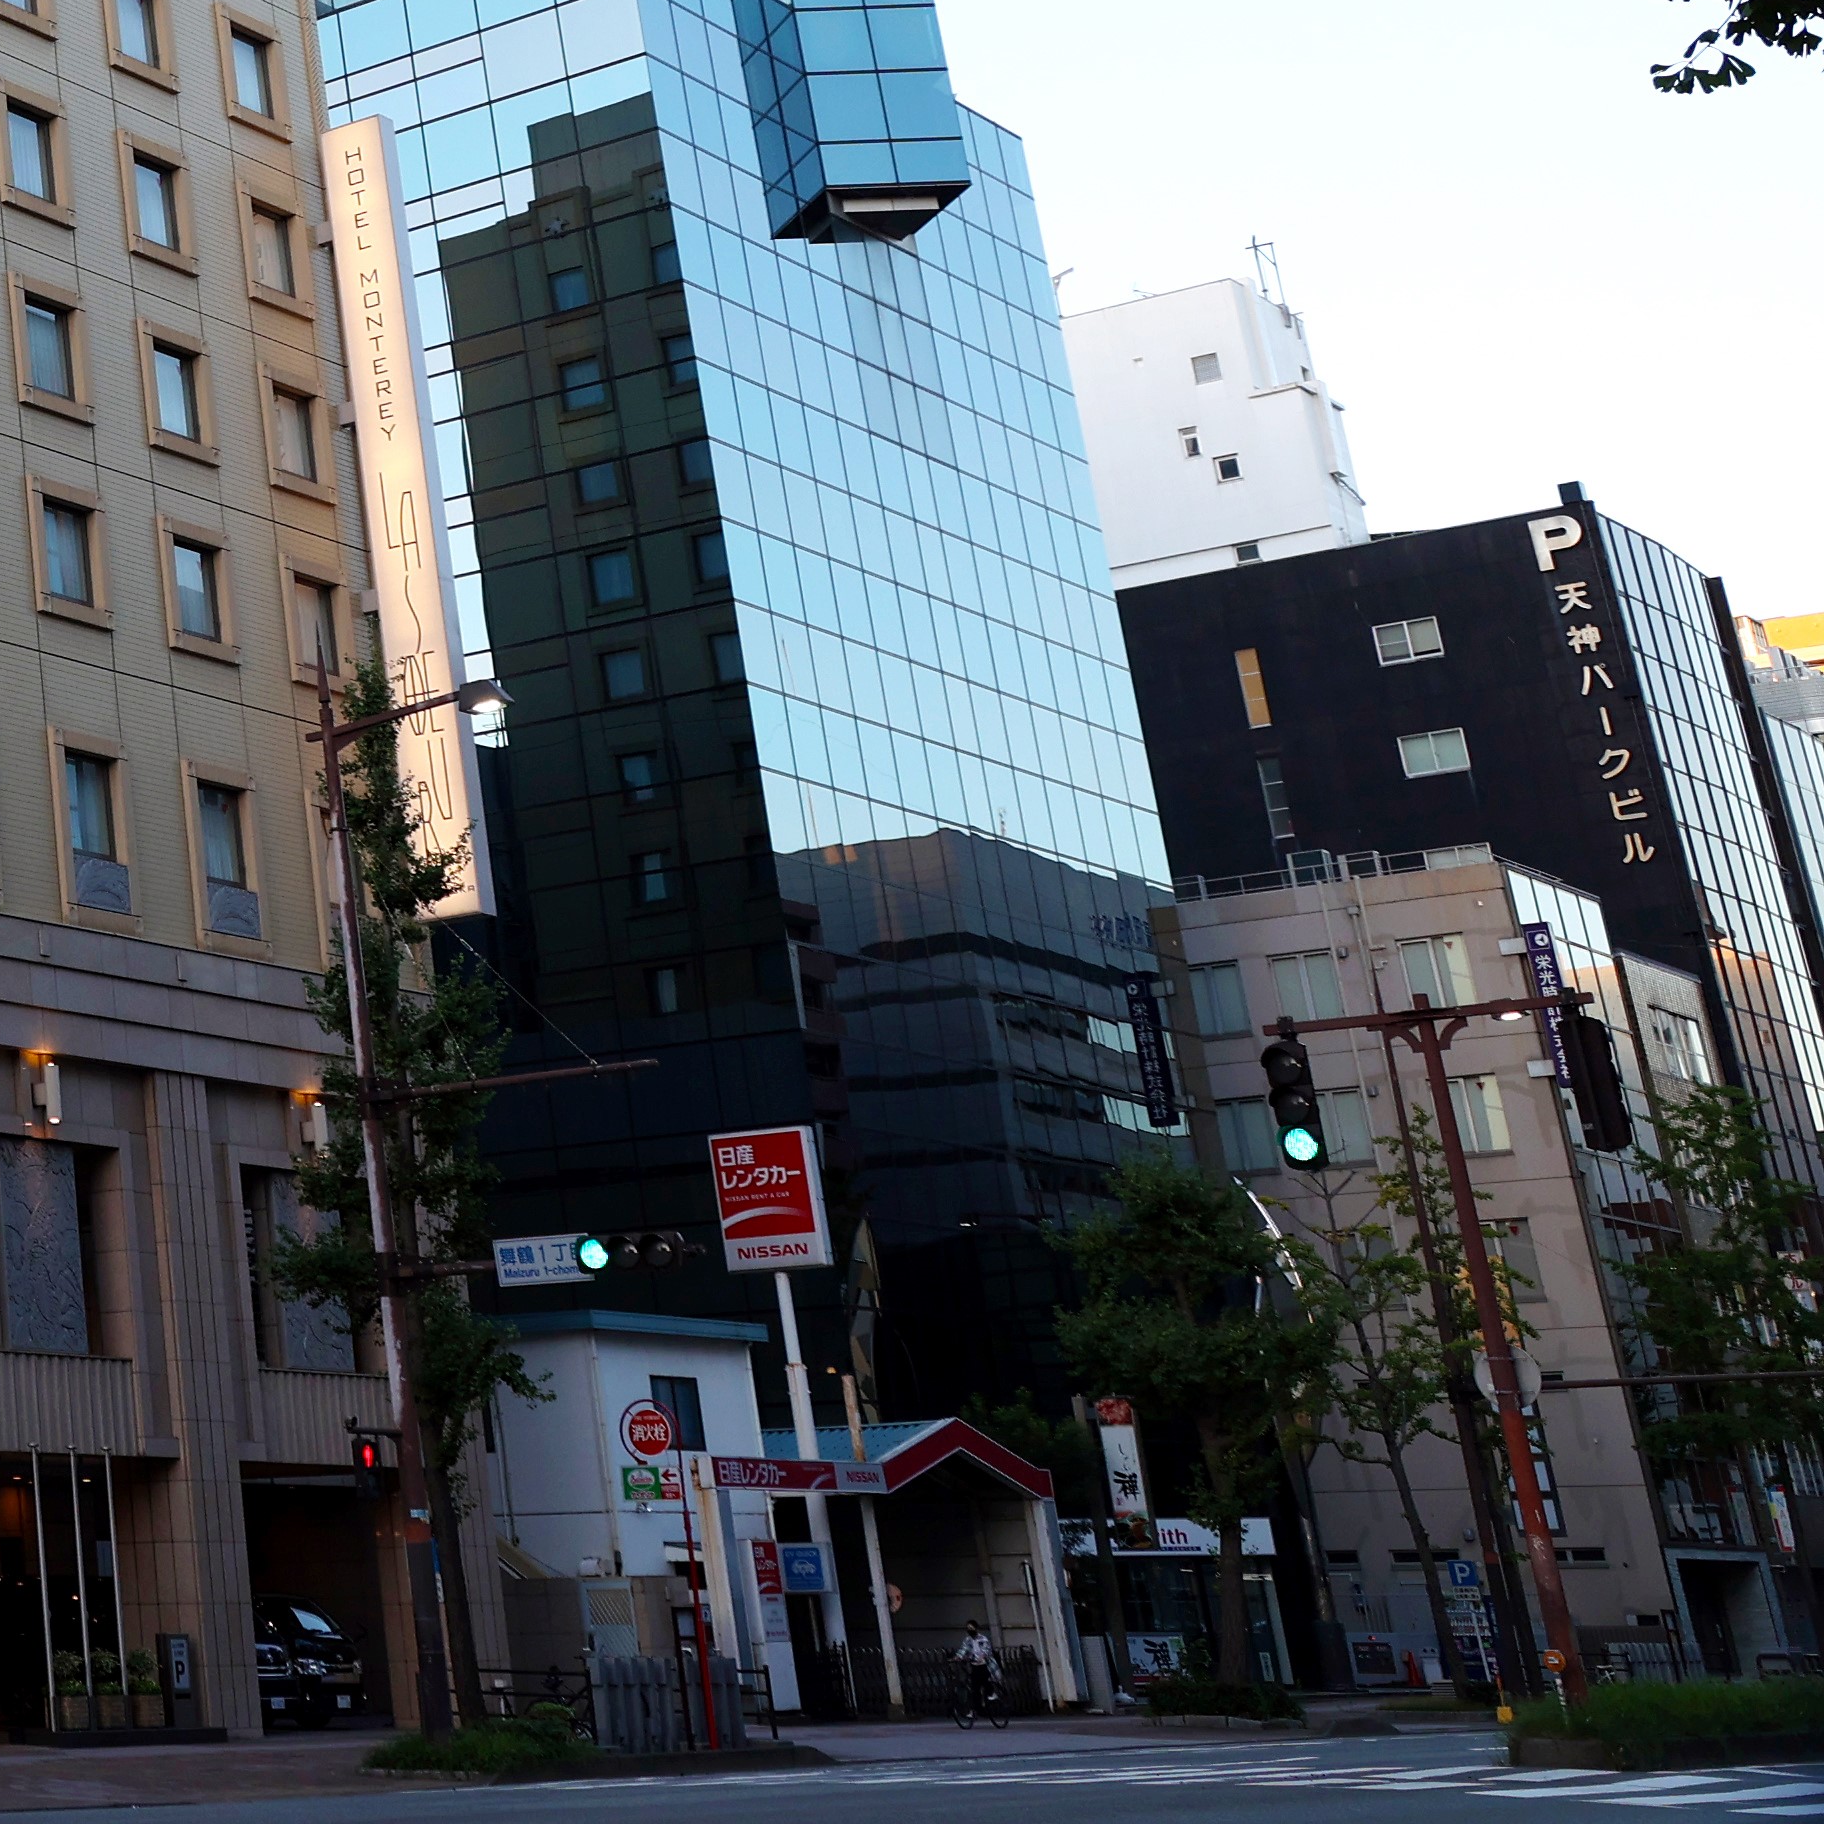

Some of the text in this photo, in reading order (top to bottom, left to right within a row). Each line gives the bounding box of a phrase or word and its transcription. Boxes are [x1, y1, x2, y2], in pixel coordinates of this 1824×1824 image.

[345, 147, 396, 442] HOTEL MONTEREY
[379, 471, 422, 571] LA
[1527, 514, 1583, 572] P
[1554, 580, 1655, 865] 天神パークビル
[717, 1144, 755, 1167] 日産
[721, 1165, 801, 1190] レンタカー
[737, 1242, 809, 1260] NISSAN
[544, 1264, 580, 1276] 1-chom
[631, 1422, 668, 1442] 消火栓
[718, 1460, 788, 1486] 日産レンタカー
[846, 1471, 880, 1483] NISSAN
[1156, 1528, 1188, 1545] ith
[1453, 1563, 1471, 1584] P
[175, 1660, 186, 1682] P
